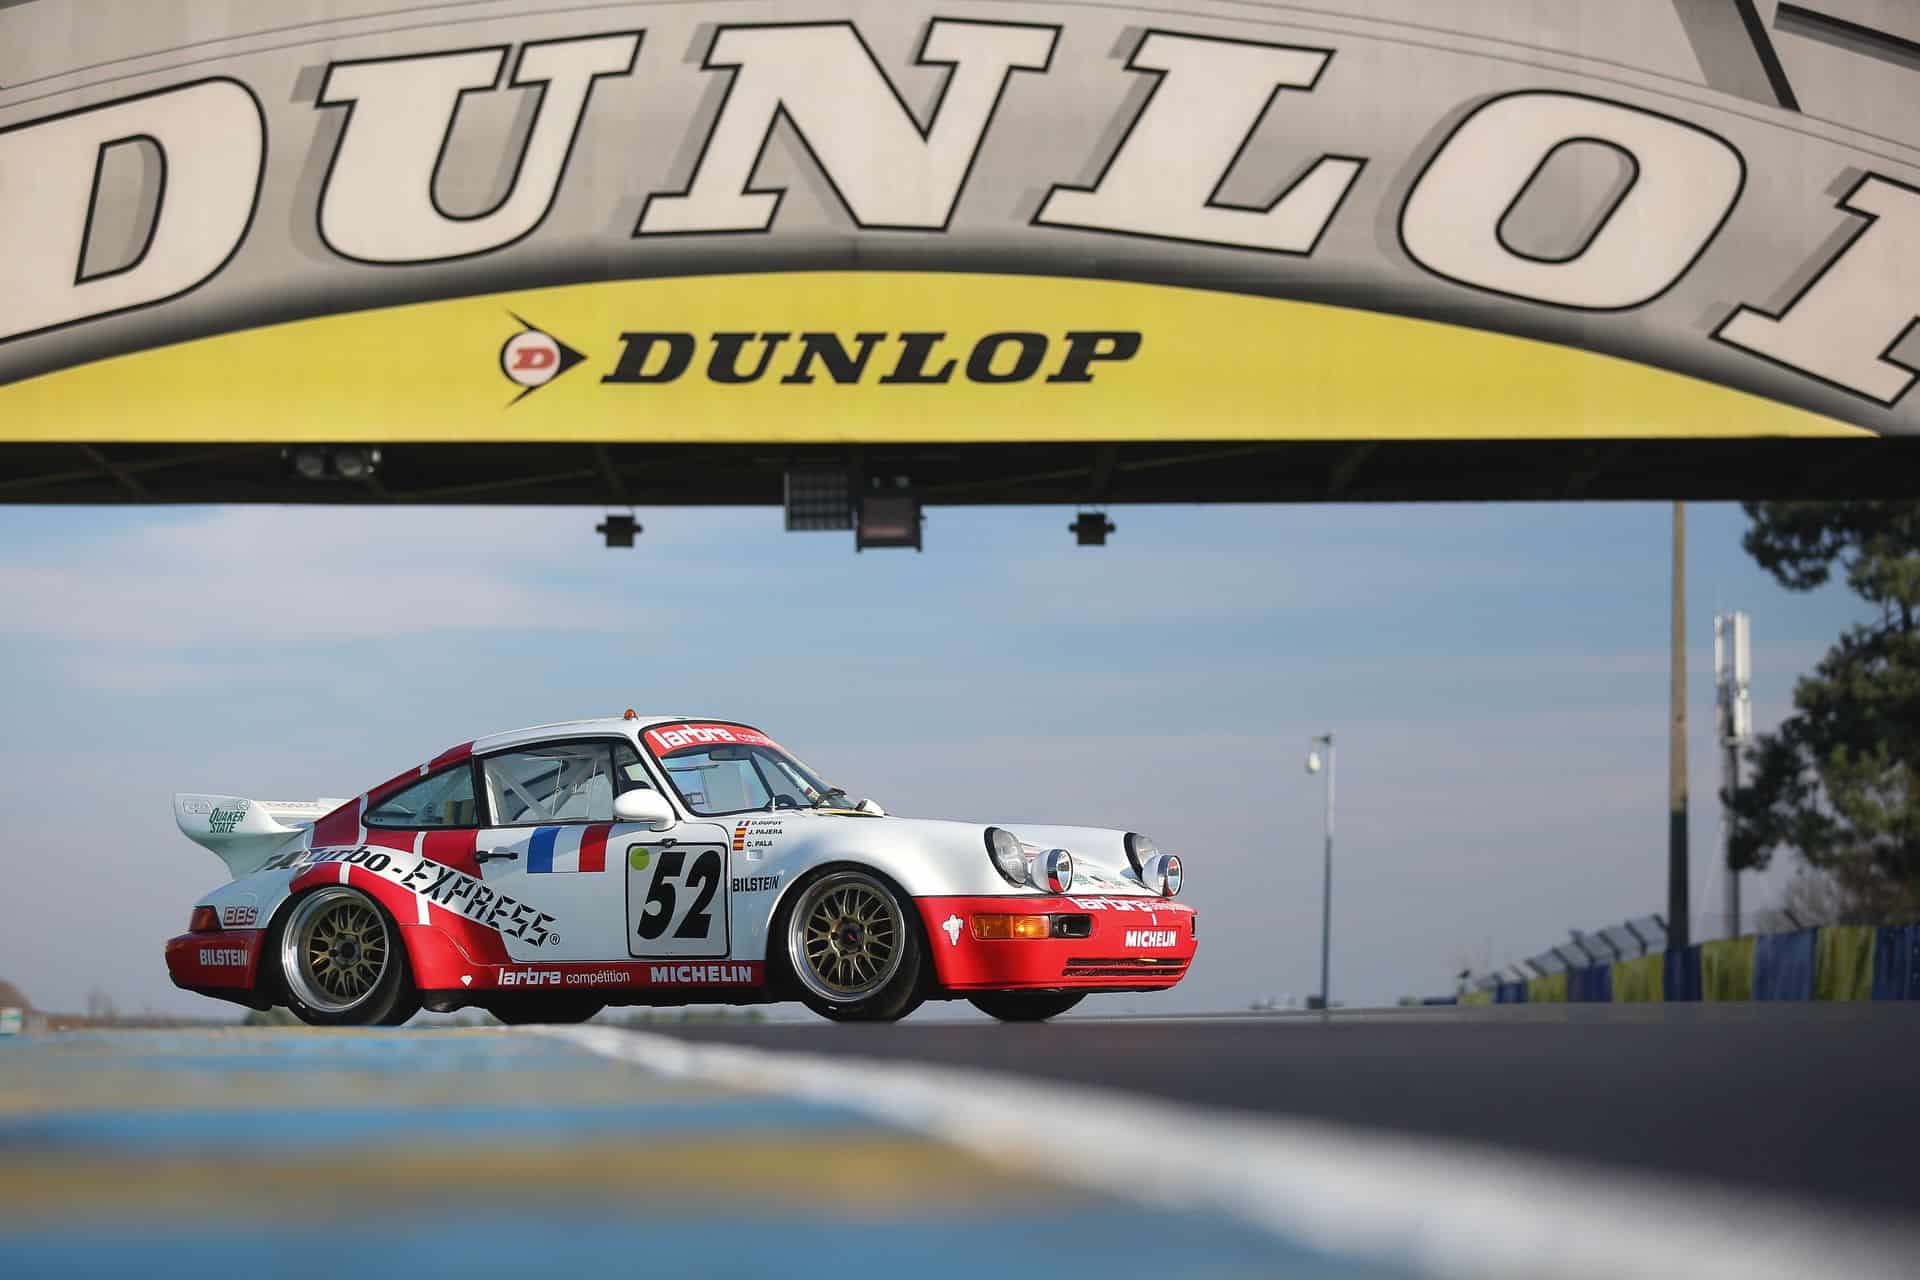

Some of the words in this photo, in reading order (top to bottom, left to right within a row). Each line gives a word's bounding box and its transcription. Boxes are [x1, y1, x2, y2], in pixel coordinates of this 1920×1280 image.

[510, 346, 557, 372] D
[600, 331, 1143, 386] DUNLOP
[649, 724, 736, 749] larbre
[210, 823, 237, 833] STATE
[732, 875, 779, 892] BILSTEIN
[637, 849, 722, 940] 52
[224, 906, 258, 926] BBS
[1124, 930, 1177, 948] MICHELIN
[199, 948, 249, 966] BILSTEIN
[498, 967, 561, 986] larbre
[565, 968, 631, 985] compétition
[650, 965, 752, 983] MICHELIN
